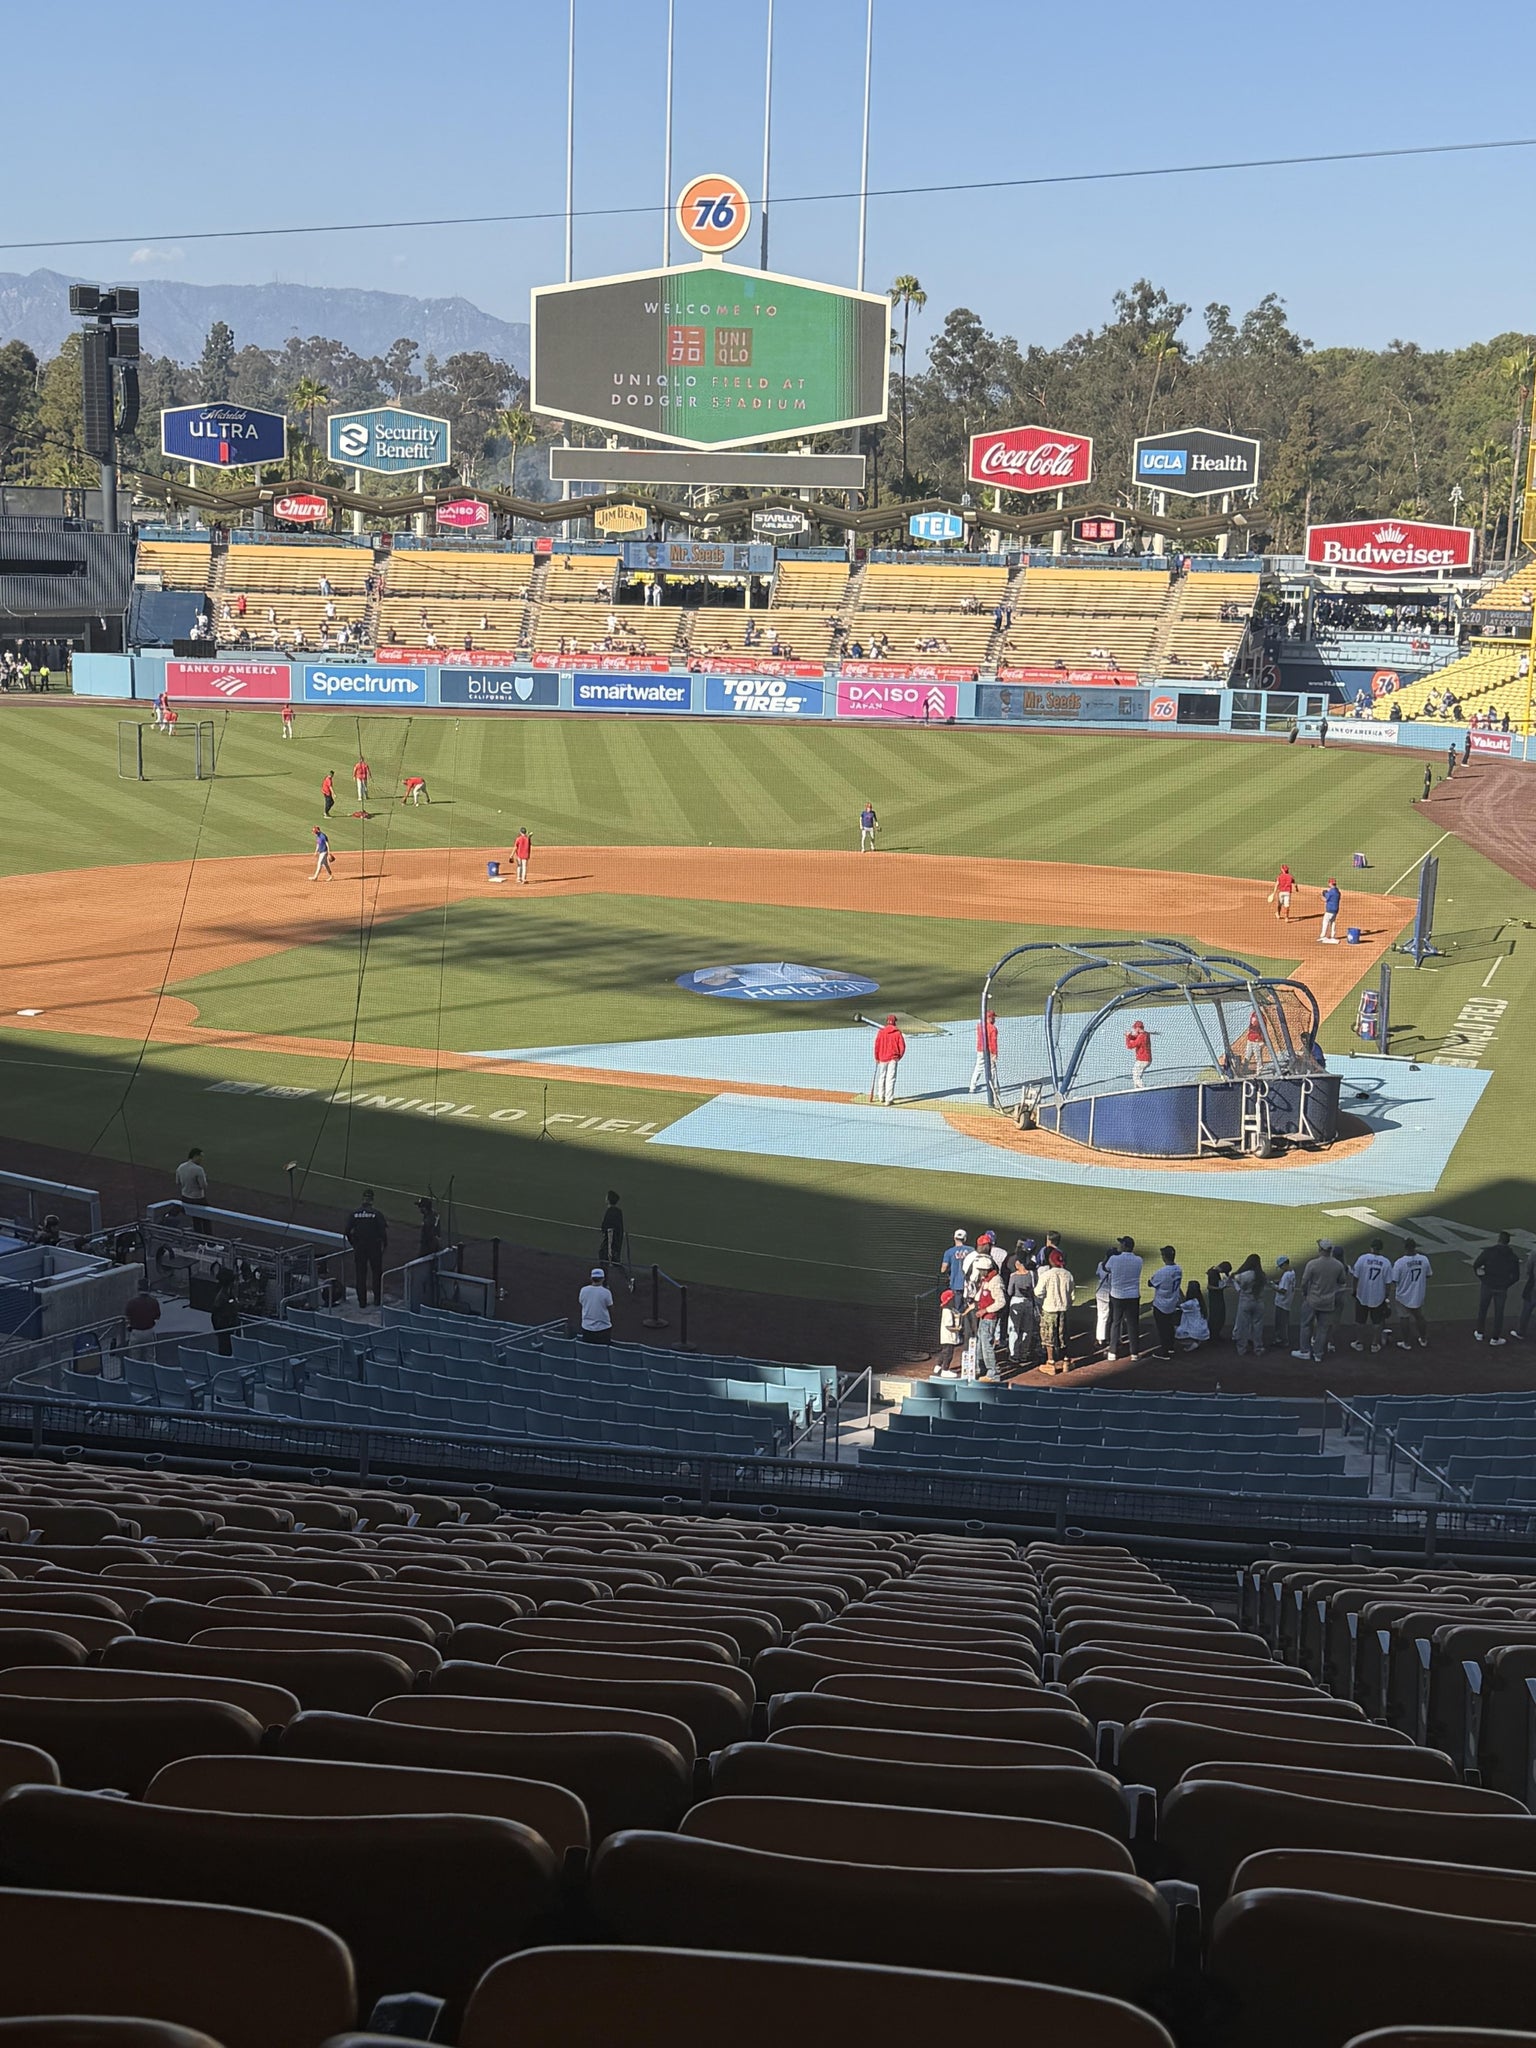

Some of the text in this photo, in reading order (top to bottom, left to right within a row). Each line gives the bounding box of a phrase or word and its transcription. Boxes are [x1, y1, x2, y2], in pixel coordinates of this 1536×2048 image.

[691, 193, 737, 231] 76
[644, 302, 778, 317] WELCOME TO
[719, 331, 747, 347] UNI
[719, 348, 750, 365] QLO
[613, 373, 805, 389] UNIQLO FIELD AT
[611, 394, 807, 410] DODGER STADIUM
[189, 421, 259, 440] ULTRA
[375, 423, 440, 445] Security
[375, 442, 434, 460] Benefit
[980, 442, 1082, 477] Coca-Cola
[1142, 453, 1249, 473] UCLA Health
[276, 498, 325, 516] Churu
[598, 509, 643, 526] JIM BEAM
[754, 513, 802, 524] STARLUX
[915, 515, 955, 537] TEL
[669, 543, 725, 562] Mr. Seeds
[1322, 541, 1455, 565] Budweiser
[1461, 611, 1481, 624] 5:20
[179, 664, 277, 676] BANK OF AMERICA
[312, 671, 411, 696] Spectrum
[468, 675, 513, 694] blue
[723, 680, 787, 697] TOYO
[1376, 674, 1397, 696] 76
[579, 683, 686, 702] smartwater
[849, 686, 919, 703] DAISO
[1023, 690, 1082, 710] Mr. Seeds
[733, 696, 803, 713] TIRES
[849, 703, 883, 711] JAPAN
[1154, 700, 1174, 716] 76
[1472, 735, 1510, 751] Yakult
[743, 982, 864, 999] Helpful
[322, 1091, 661, 1136] UNIQLO FIEL
[1368, 1267, 1382, 1281] 17
[1411, 1267, 1422, 1282] 17
